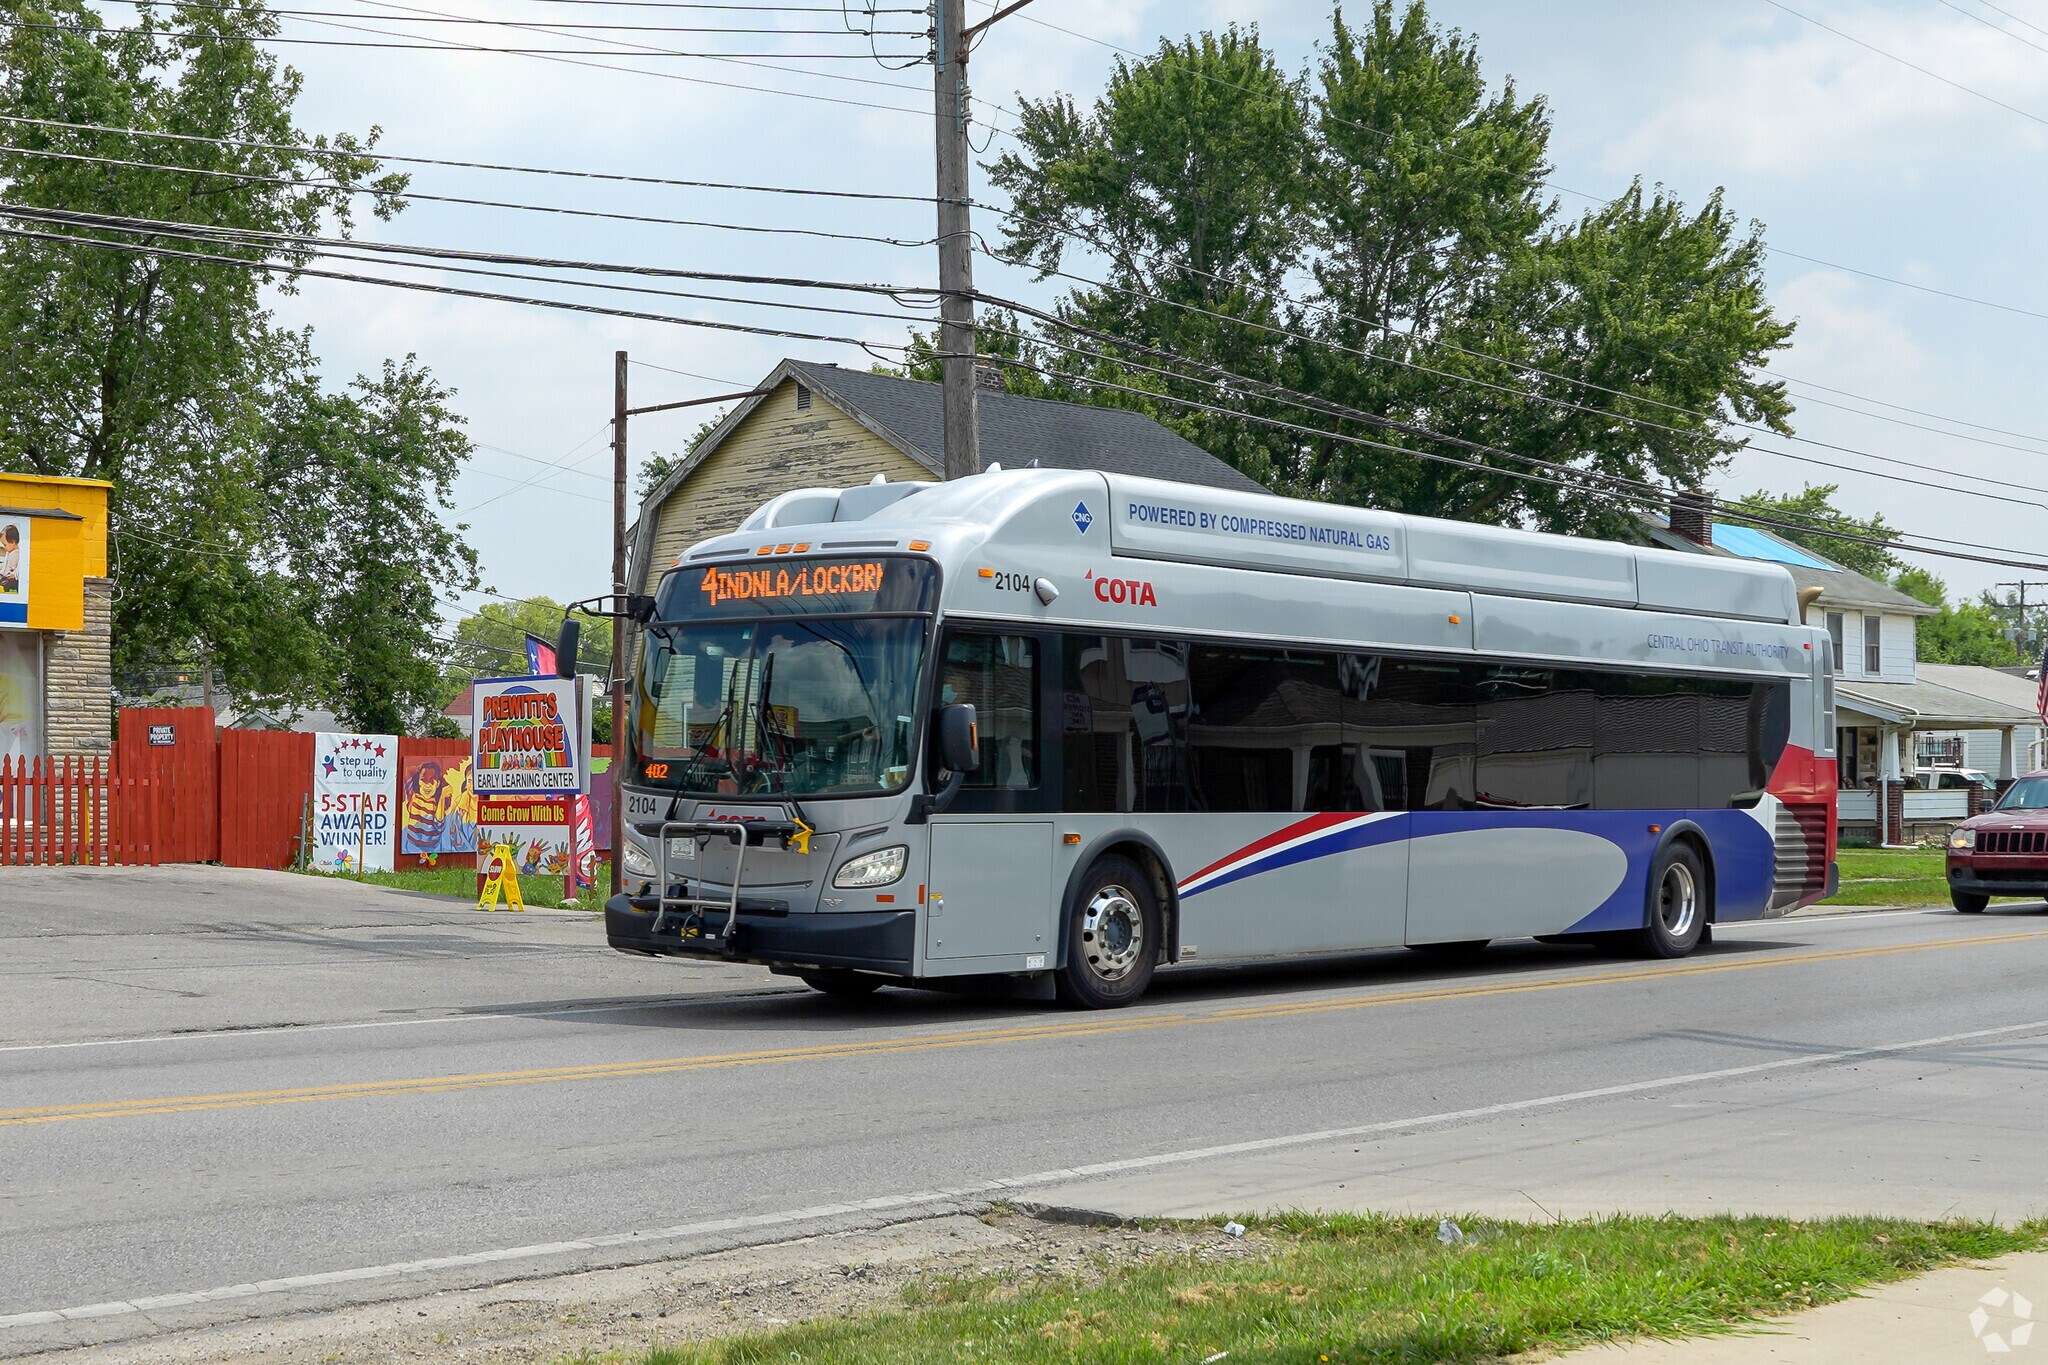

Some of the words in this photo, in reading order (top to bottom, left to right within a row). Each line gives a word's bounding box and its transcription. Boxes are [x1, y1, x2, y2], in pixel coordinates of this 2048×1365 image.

[1073, 512, 1091, 523] CNG
[1129, 503, 1196, 527] POWERED
[1200, 512, 1217, 530] BY
[1221, 514, 1306, 541] COMPRESSED
[1309, 526, 1363, 548] NATURAL
[1366, 533, 1390, 551] GAS
[995, 571, 1030, 593] 2104
[1094, 577, 1157, 607] COTA
[1647, 633, 1685, 651] CENTRAL
[1687, 637, 1709, 653] OHIO
[1711, 639, 1743, 655] TRANSIT
[1746, 643, 1790, 659] AUTHORITY
[483, 692, 558, 721] PREWITT'S
[150, 733, 174, 741] PROPERTY
[153, 726, 171, 734] PRIVATE
[479, 725, 564, 753] PLAYHOUSE
[340, 756, 360, 768] step
[363, 757, 376, 768] up
[343, 767, 353, 777] to
[355, 767, 387, 780] quality
[645, 763, 668, 779] 402
[478, 774, 500, 788] EARLY
[501, 773, 541, 788] LEARNING
[542, 772, 575, 787] CENTER
[321, 794, 387, 813] 5-STAR
[628, 796, 656, 815] 2104
[320, 813, 387, 830] AWARD
[481, 805, 505, 822] Come
[506, 805, 529, 822] Grow
[531, 805, 552, 822] With
[553, 805, 565, 822] Us
[320, 831, 387, 846] WINNER!
